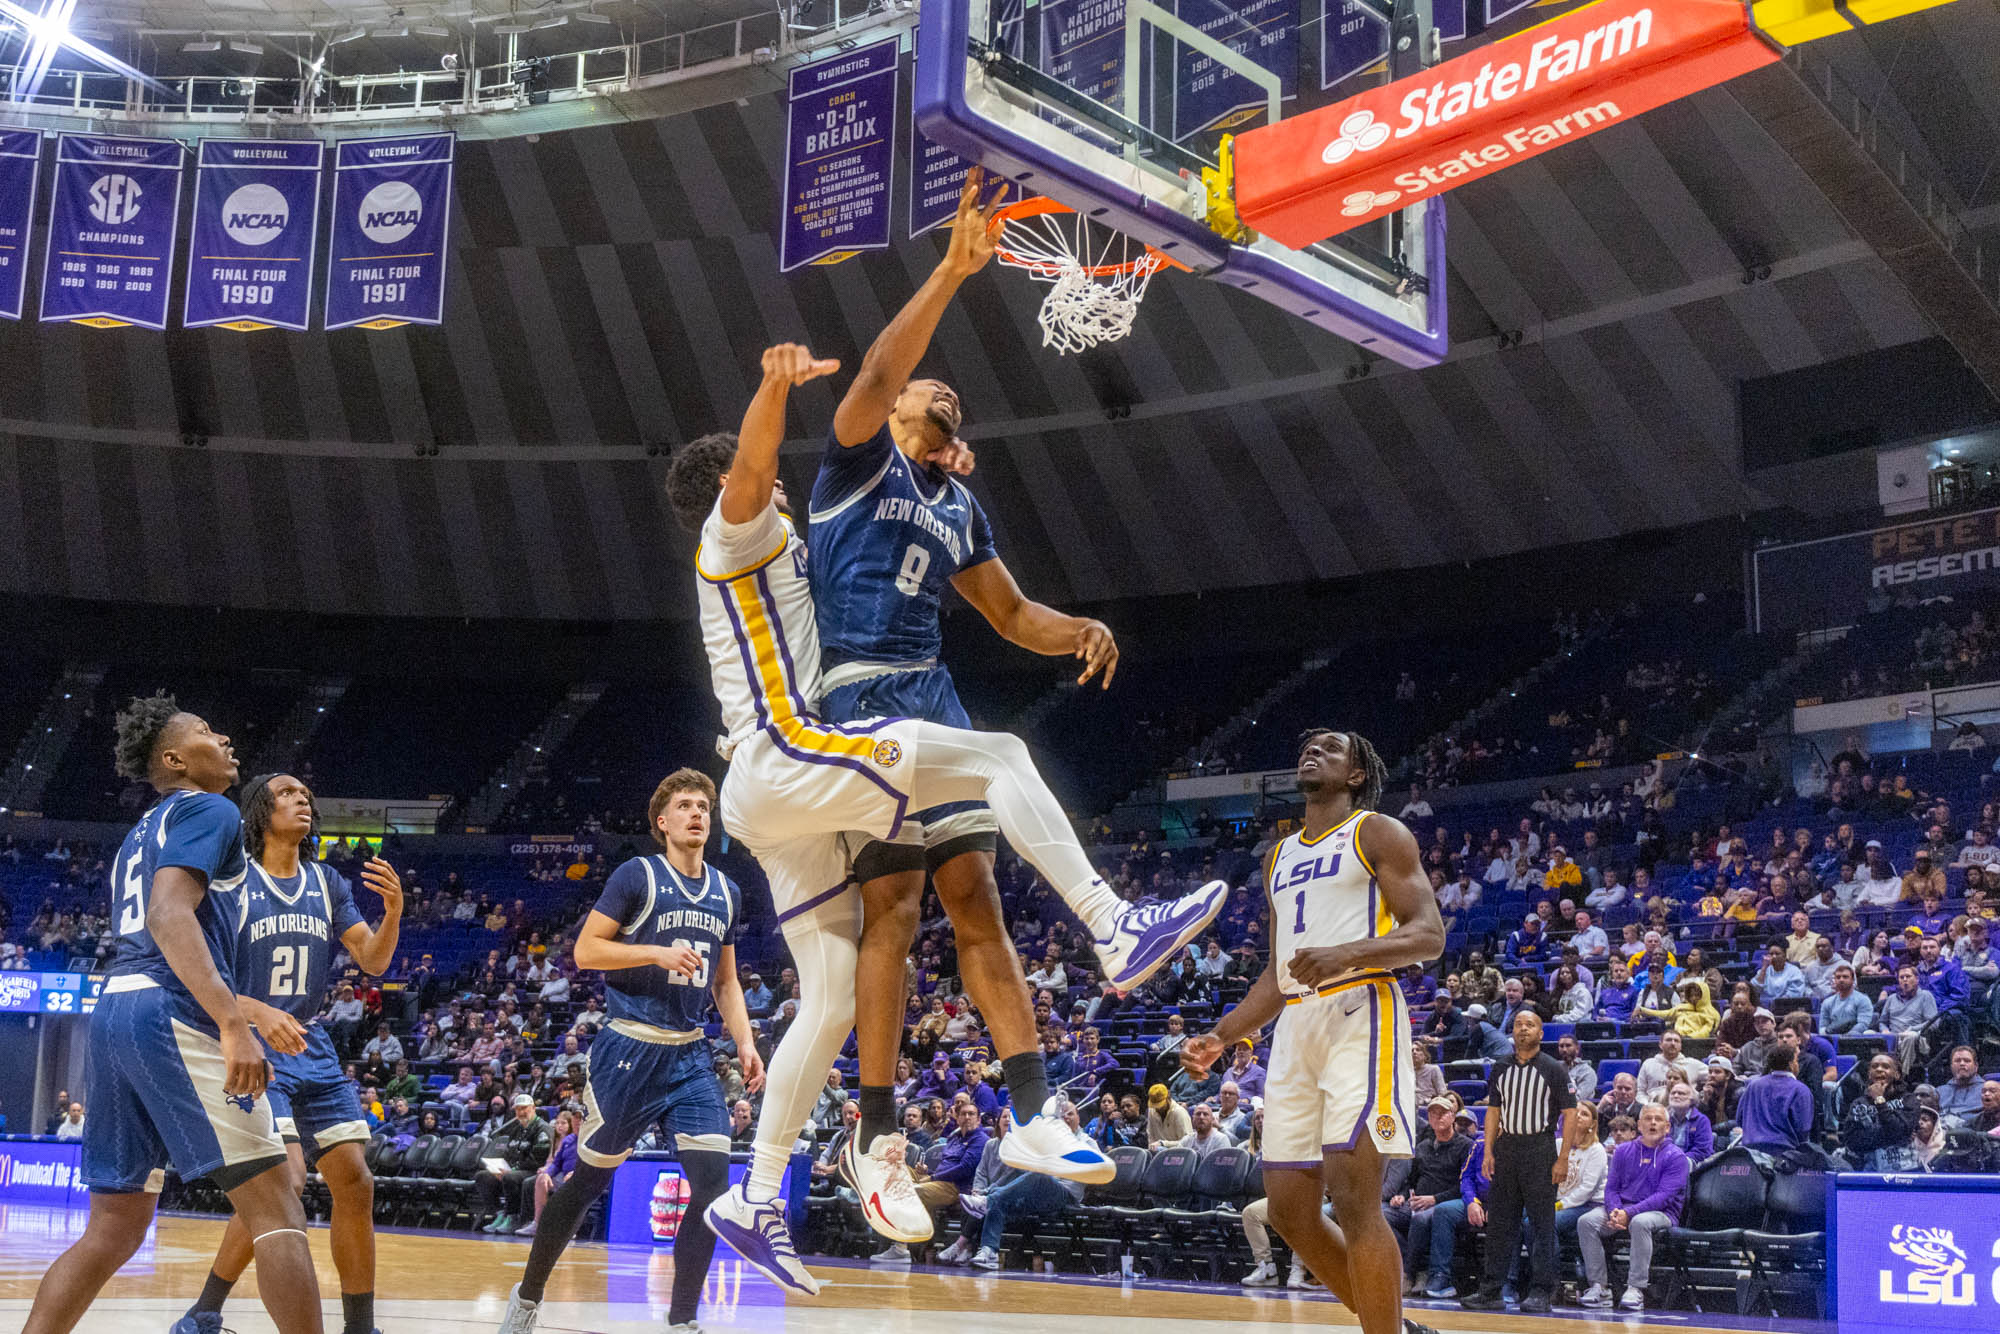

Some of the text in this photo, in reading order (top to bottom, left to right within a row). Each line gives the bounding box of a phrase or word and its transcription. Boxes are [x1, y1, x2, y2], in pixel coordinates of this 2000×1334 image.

[1061, 8, 1126, 46] CHAMPION
[1341, 16, 1365, 36] 2017
[1260, 28, 1286, 47] 2018
[817, 57, 870, 81] GYMNASTICS
[1191, 74, 1215, 92] 2019
[829, 91, 855, 106] COACH
[806, 117, 876, 154] BREAUX
[93, 145, 149, 158] VOLLEYBALL
[233, 149, 288, 160] VOLLEYBALL
[368, 145, 421, 158] VOLLEYBALL
[829, 155, 861, 171] SEASONS
[924, 155, 959, 174] JACKSON
[821, 173, 839, 184] NCAA
[840, 165, 865, 180] FINALS
[806, 188, 820, 199] SEC
[821, 172, 880, 195] CHAMPIONSHIPS
[89, 174, 143, 224] SEC
[809, 191, 854, 210] ALL-AMERICA
[855, 182, 885, 197] HONORS
[840, 198, 874, 213] NATIONAL
[229, 213, 285, 230] NCAA
[365, 209, 419, 229] NCAA
[804, 206, 873, 231] COACH OF THE YEAR
[835, 222, 854, 234] WINS
[79, 231, 145, 245] CHAMPIONS
[212, 267, 287, 282] FINAL FOUR
[350, 265, 421, 282] FINAL FOUR
[60, 277, 152, 292] 1990 1991 2009
[222, 284, 274, 305] 1990
[362, 282, 407, 304] 1991
[873, 498, 915, 522] NEW
[1872, 518, 1981, 560] PETE
[1274, 854, 1342, 895] LSU
[1294, 890, 1306, 935] 1
[250, 913, 328, 944] NEW ORLEANS
[656, 910, 726, 942] NEW ORLEANS
[269, 946, 308, 996] 21
[46, 992, 73, 1011] 32
[11, 1160, 55, 1186] Download
[55, 1162, 71, 1188] the
[1880, 1269, 1976, 1306] LSU
